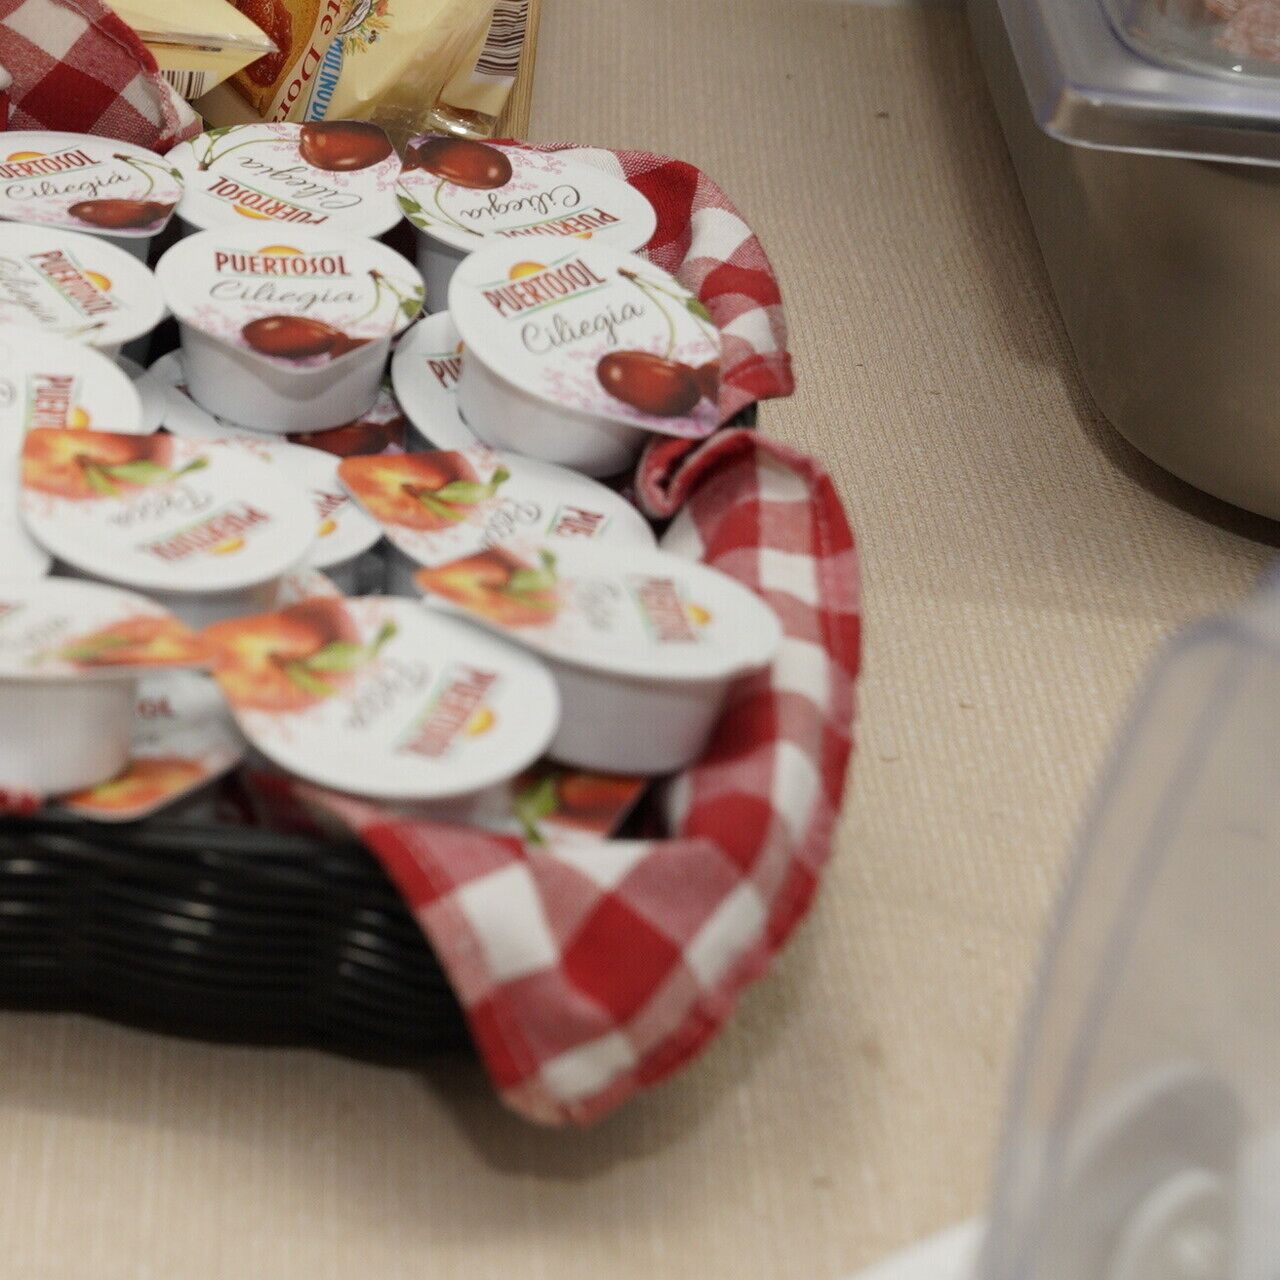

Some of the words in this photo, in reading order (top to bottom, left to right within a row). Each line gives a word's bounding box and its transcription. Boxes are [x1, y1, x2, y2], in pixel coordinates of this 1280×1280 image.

[2, 171, 134, 203] Ciliegia
[206, 175, 332, 225] PUERTOSOL
[237, 153, 365, 211] Ciliegia
[457, 183, 584, 220] Ciliegia
[26, 247, 122, 318] PUERTOSOL
[211, 249, 354, 279] PUERTOSOL
[481, 256, 609, 319] PUERTOSOL
[208, 277, 360, 304] Ciliegia
[519, 297, 649, 358] Ciliegia
